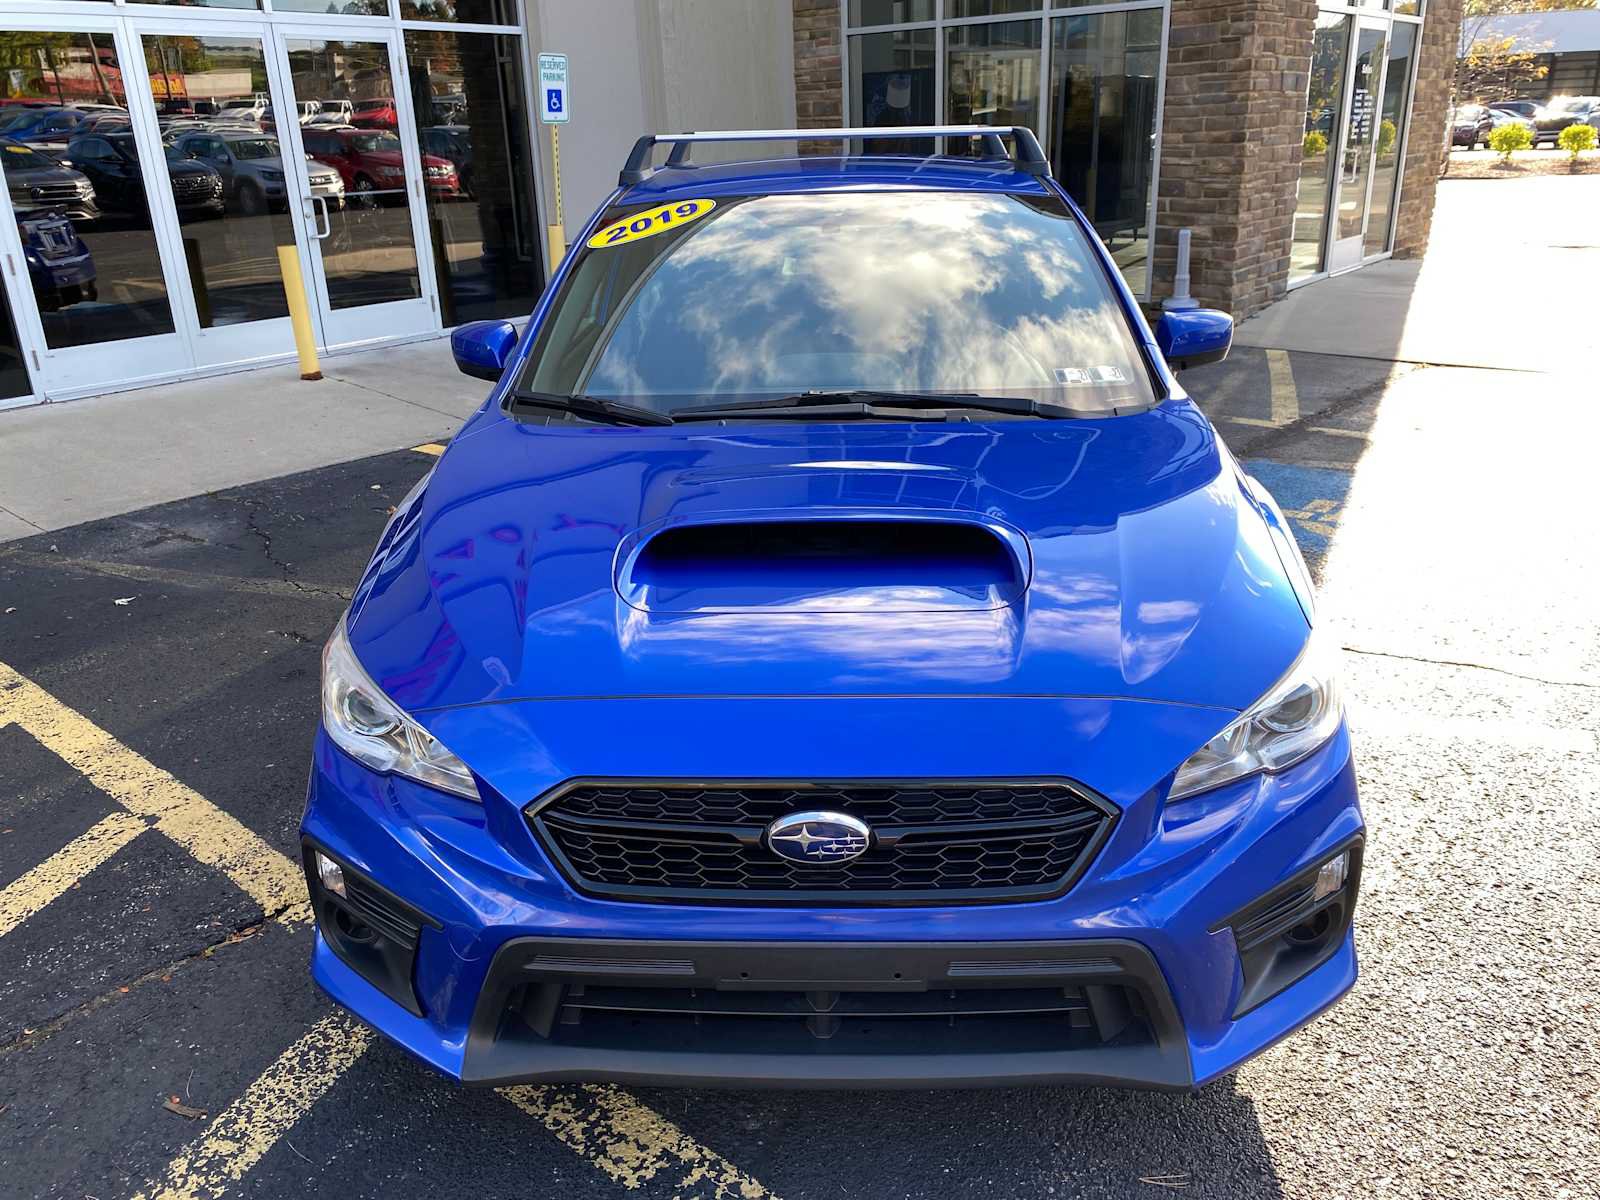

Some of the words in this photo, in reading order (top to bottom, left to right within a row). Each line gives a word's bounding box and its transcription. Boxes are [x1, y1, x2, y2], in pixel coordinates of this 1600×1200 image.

[540, 61, 565, 70] RESERVED
[543, 72, 565, 81] PARKING
[606, 202, 698, 243] 2019
